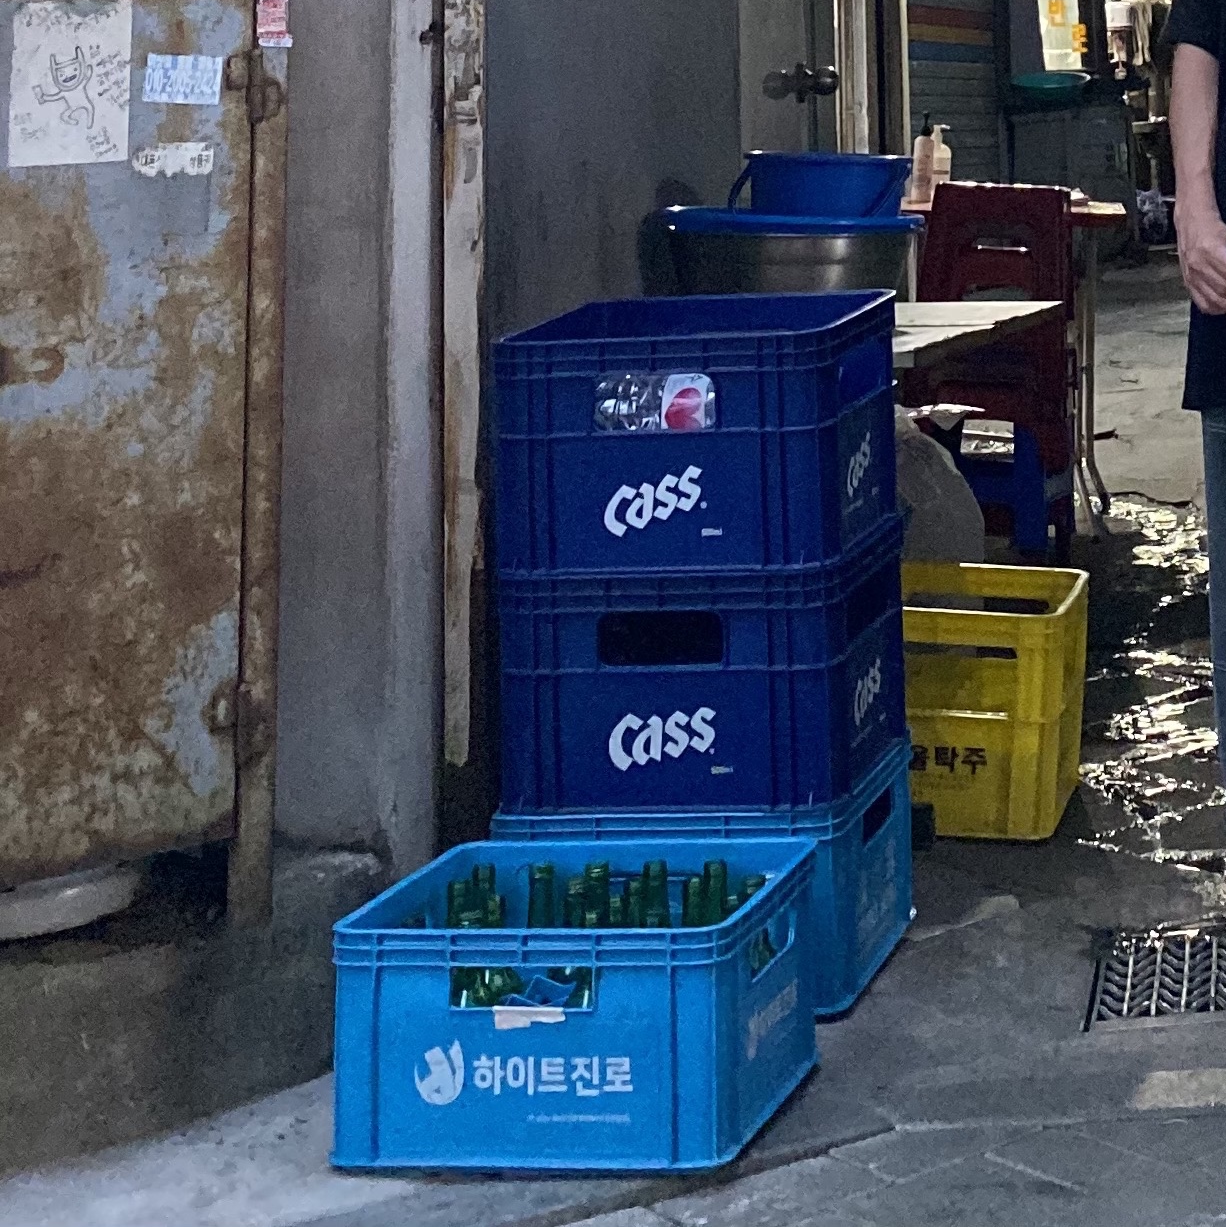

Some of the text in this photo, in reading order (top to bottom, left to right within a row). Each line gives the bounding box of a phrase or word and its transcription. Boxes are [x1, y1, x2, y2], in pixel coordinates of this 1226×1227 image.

[604, 464, 703, 537] Cass
[608, 706, 717, 772] Cass
[908, 744, 988, 775] 울탁주
[472, 1054, 634, 1097] 하이트진로
